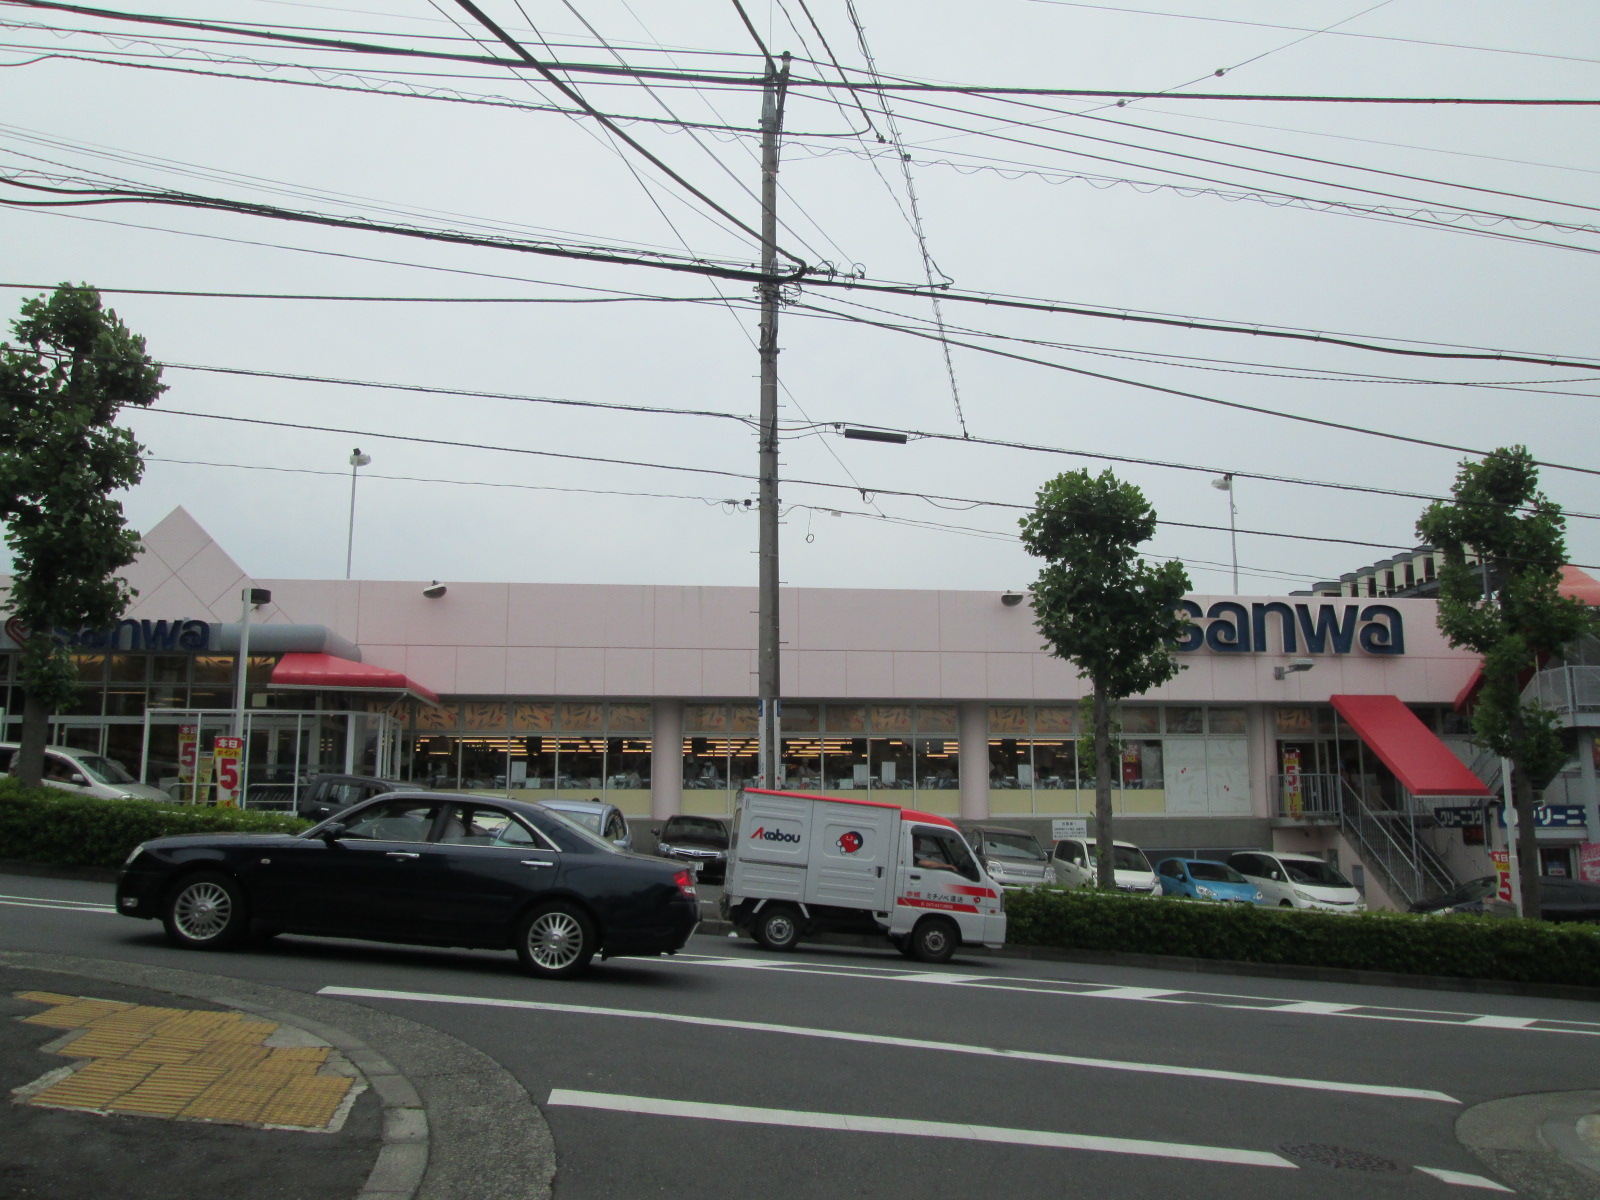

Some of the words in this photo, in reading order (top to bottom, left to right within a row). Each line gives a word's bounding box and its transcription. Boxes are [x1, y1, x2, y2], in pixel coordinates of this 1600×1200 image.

[1168, 600, 1405, 656] sanwa
[218, 738, 239, 749] 本日
[216, 750, 240, 758] ポイント
[219, 757, 239, 790] 5
[1532, 808, 1587, 826] リーニ
[750, 826, 801, 844] Akabou
[1498, 872, 1512, 902] 5
